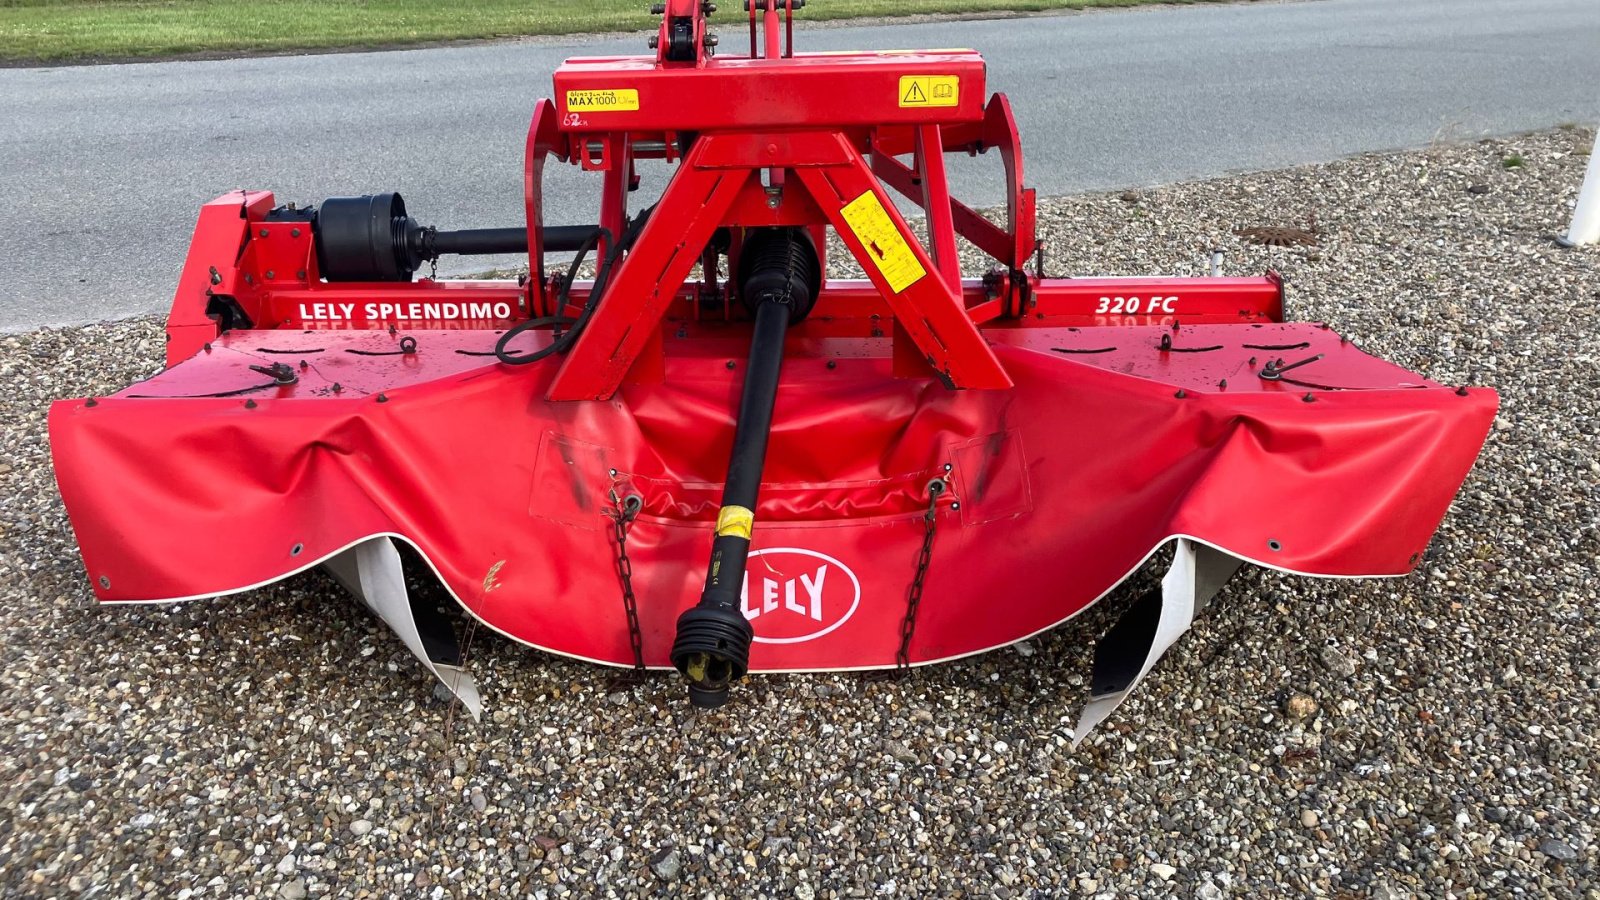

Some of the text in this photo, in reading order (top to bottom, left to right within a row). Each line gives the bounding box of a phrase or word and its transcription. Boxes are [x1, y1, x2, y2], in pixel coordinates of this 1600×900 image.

[569, 97, 594, 106] MAX
[595, 96, 617, 105] 1000
[300, 302, 511, 320] LELY SPLENDIMO
[1095, 296, 1179, 314] 320 FC
[740, 564, 828, 622] LELY
